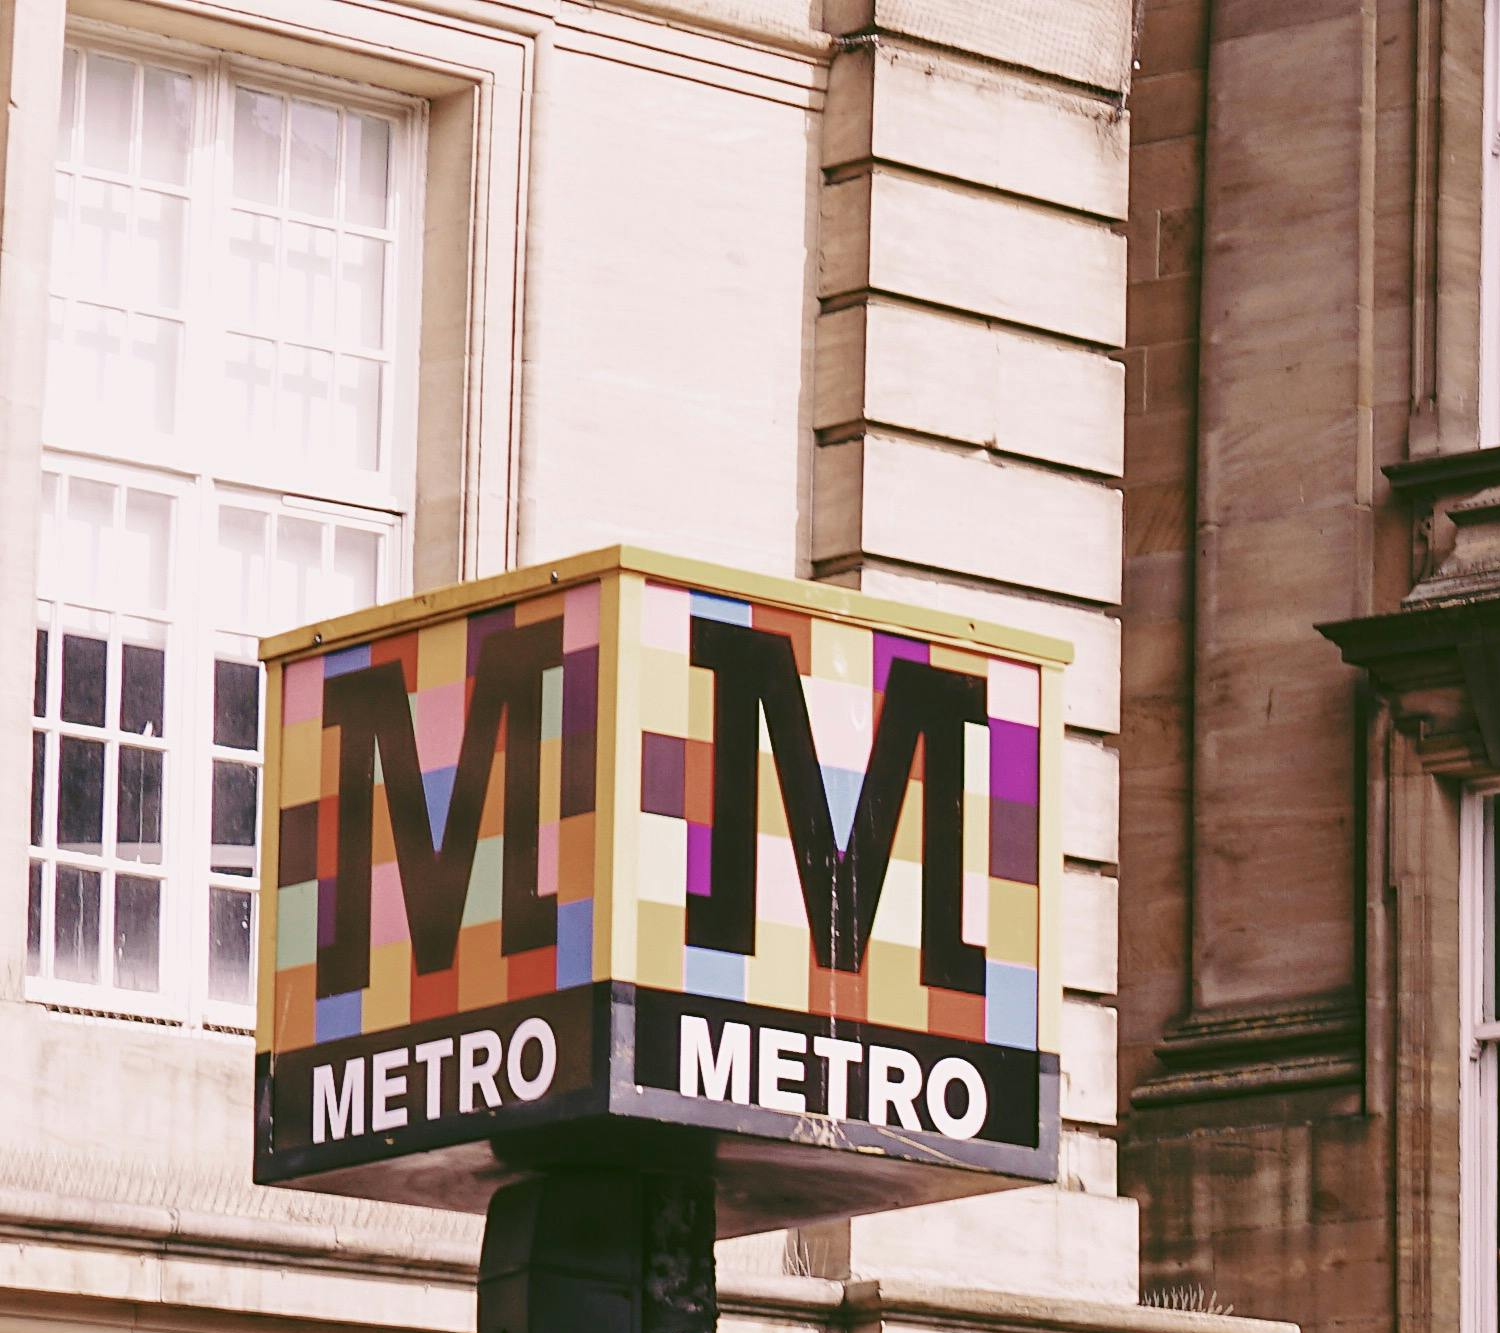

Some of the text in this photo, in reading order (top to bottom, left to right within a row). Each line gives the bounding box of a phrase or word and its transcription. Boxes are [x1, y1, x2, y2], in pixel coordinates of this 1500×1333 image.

[316, 615, 563, 999] M
[685, 615, 988, 995] M
[312, 1017, 557, 1144] METRO
[680, 1015, 988, 1140] METRO
